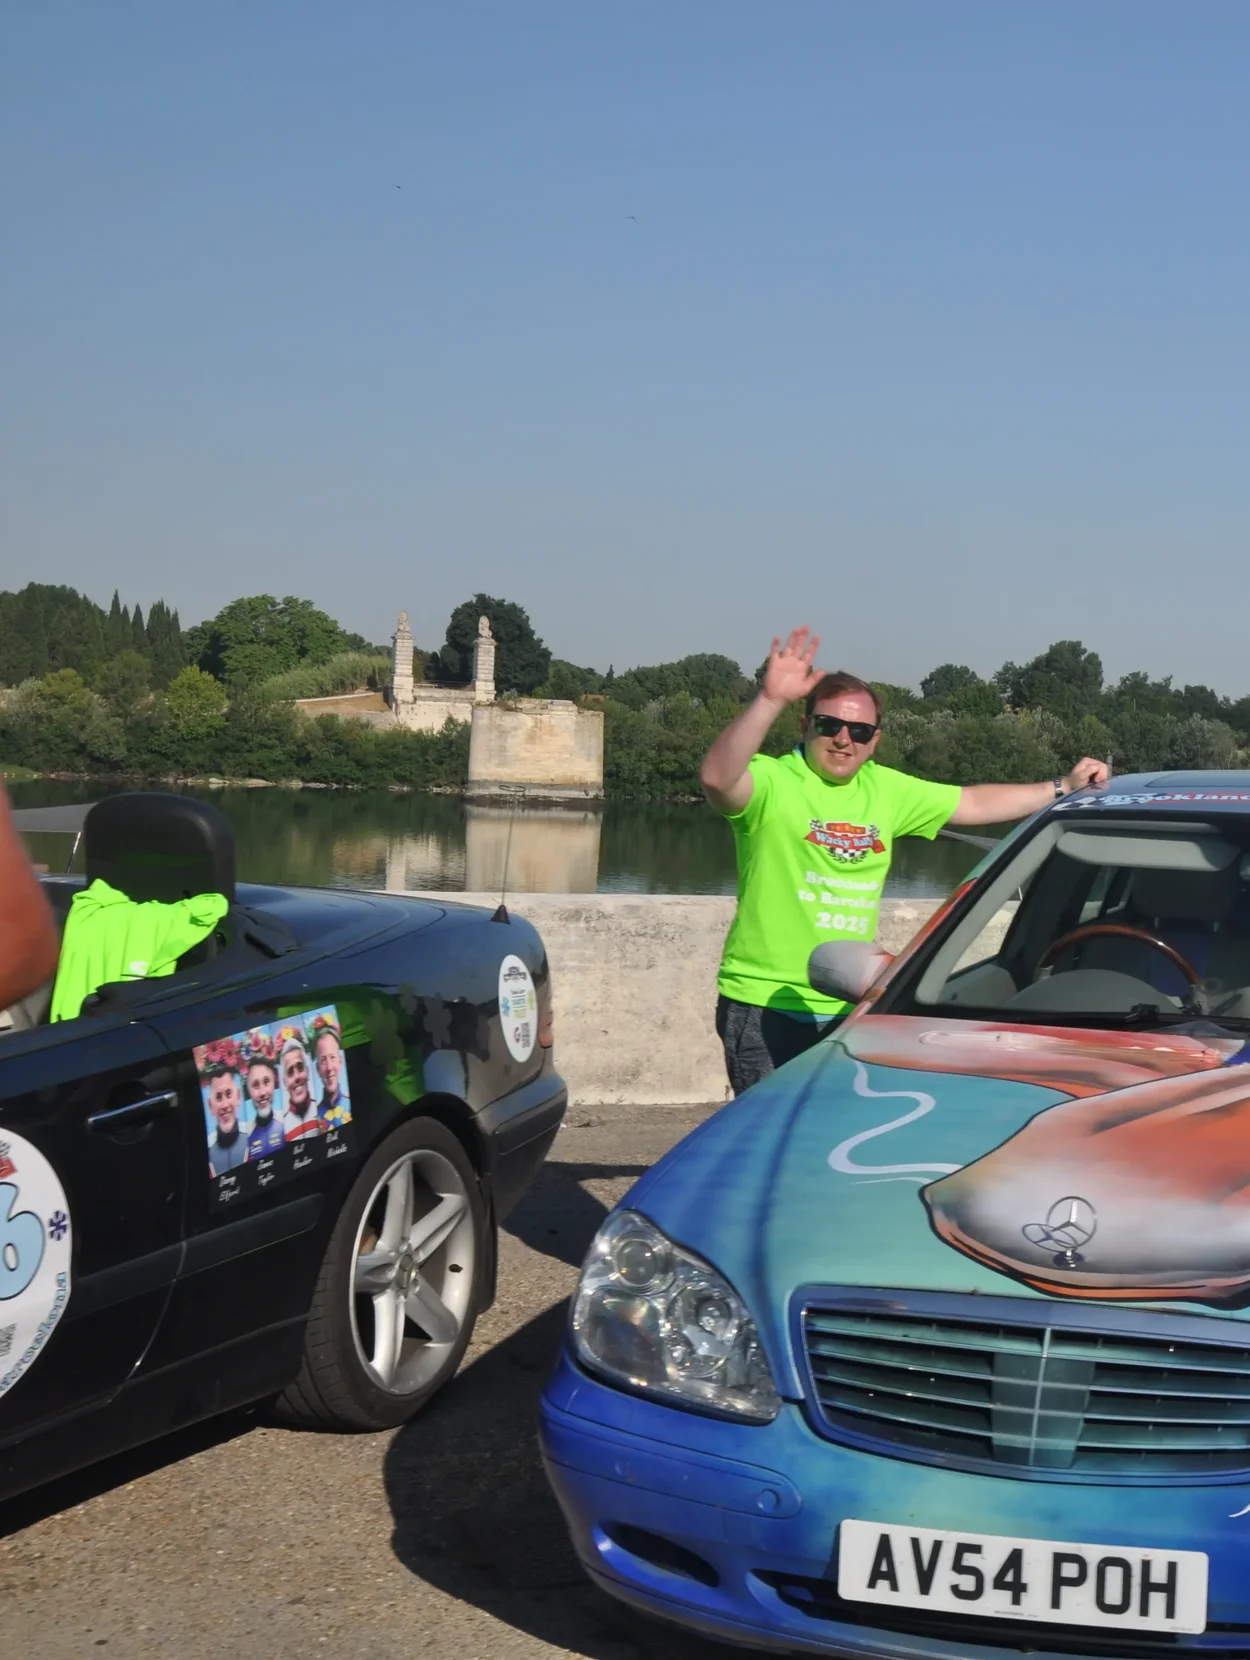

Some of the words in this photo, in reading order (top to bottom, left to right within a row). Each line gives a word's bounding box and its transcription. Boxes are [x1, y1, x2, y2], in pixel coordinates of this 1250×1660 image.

[815, 911, 869, 935] 2025
[866, 1533, 1028, 1606] AV54
[1050, 1551, 1178, 1620] POH
